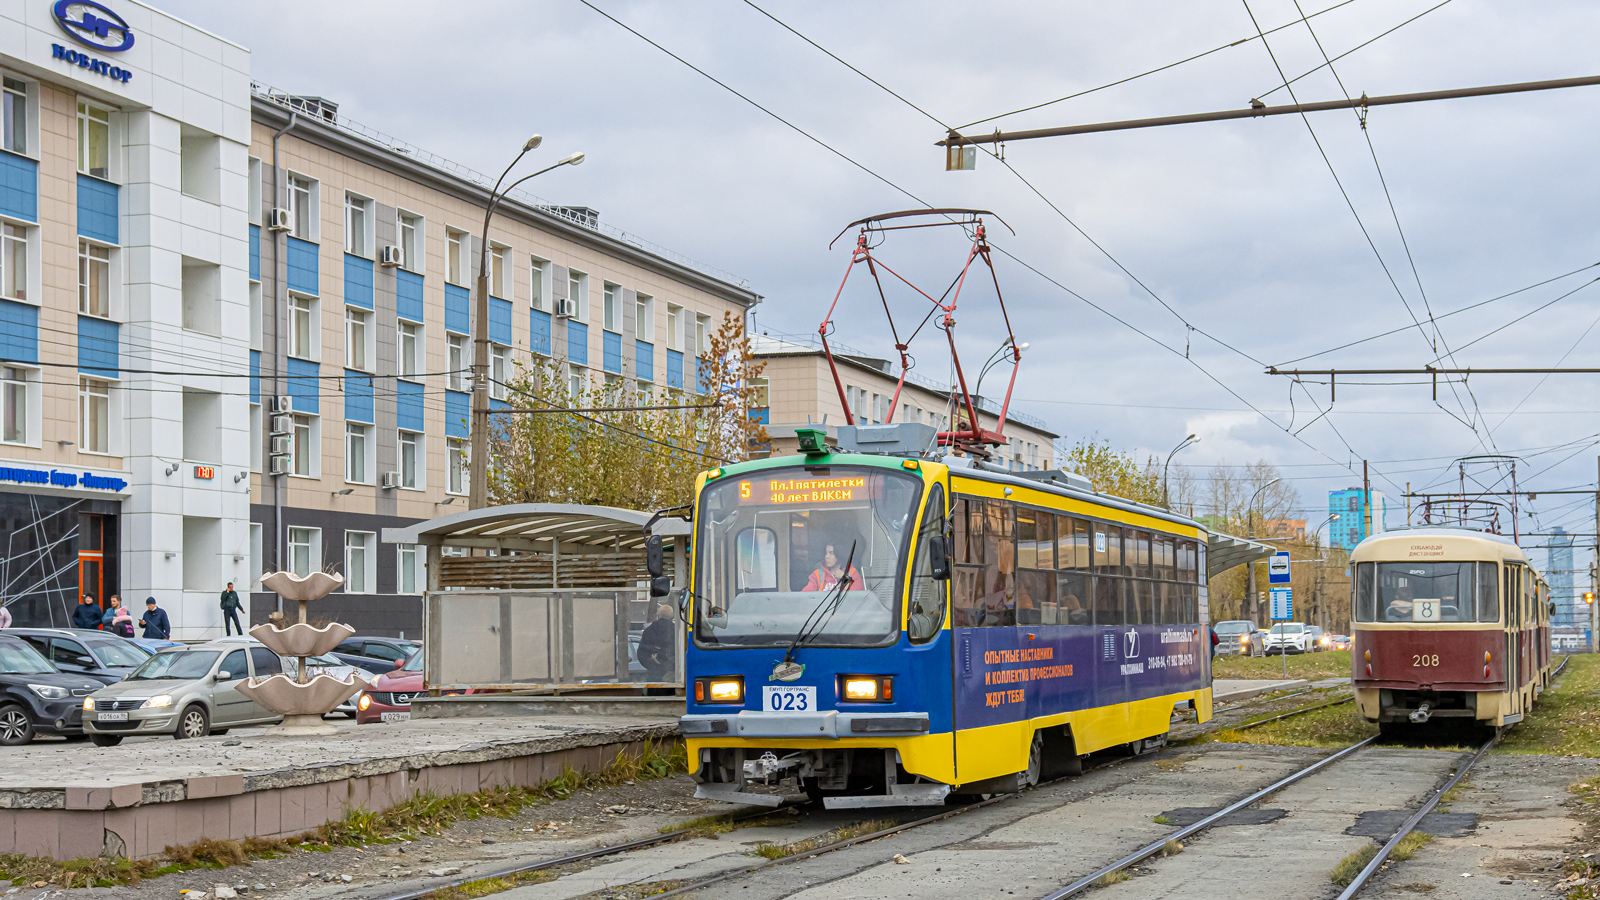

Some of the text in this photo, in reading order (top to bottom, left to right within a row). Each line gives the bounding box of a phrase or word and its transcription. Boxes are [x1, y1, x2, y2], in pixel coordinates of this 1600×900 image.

[51, 43, 132, 83] НОВАТОР
[50, 469, 77, 488] бюро
[78, 472, 127, 491] «Новатор»
[740, 481, 751, 498] 5
[770, 489, 852, 503] 40 лет ВЛКСМ
[1422, 601, 1432, 618] 8
[984, 647, 1054, 665] ОПЫТНЫЕ НАСТАВНИКИ
[1412, 654, 1440, 667] 208
[985, 664, 1074, 686] И КОЛЛЕКТИВ ПРОФЕССИОНАЛОВ
[771, 692, 808, 711] 023
[985, 688, 1025, 708] ЖДУТ ТЕБЯ!
